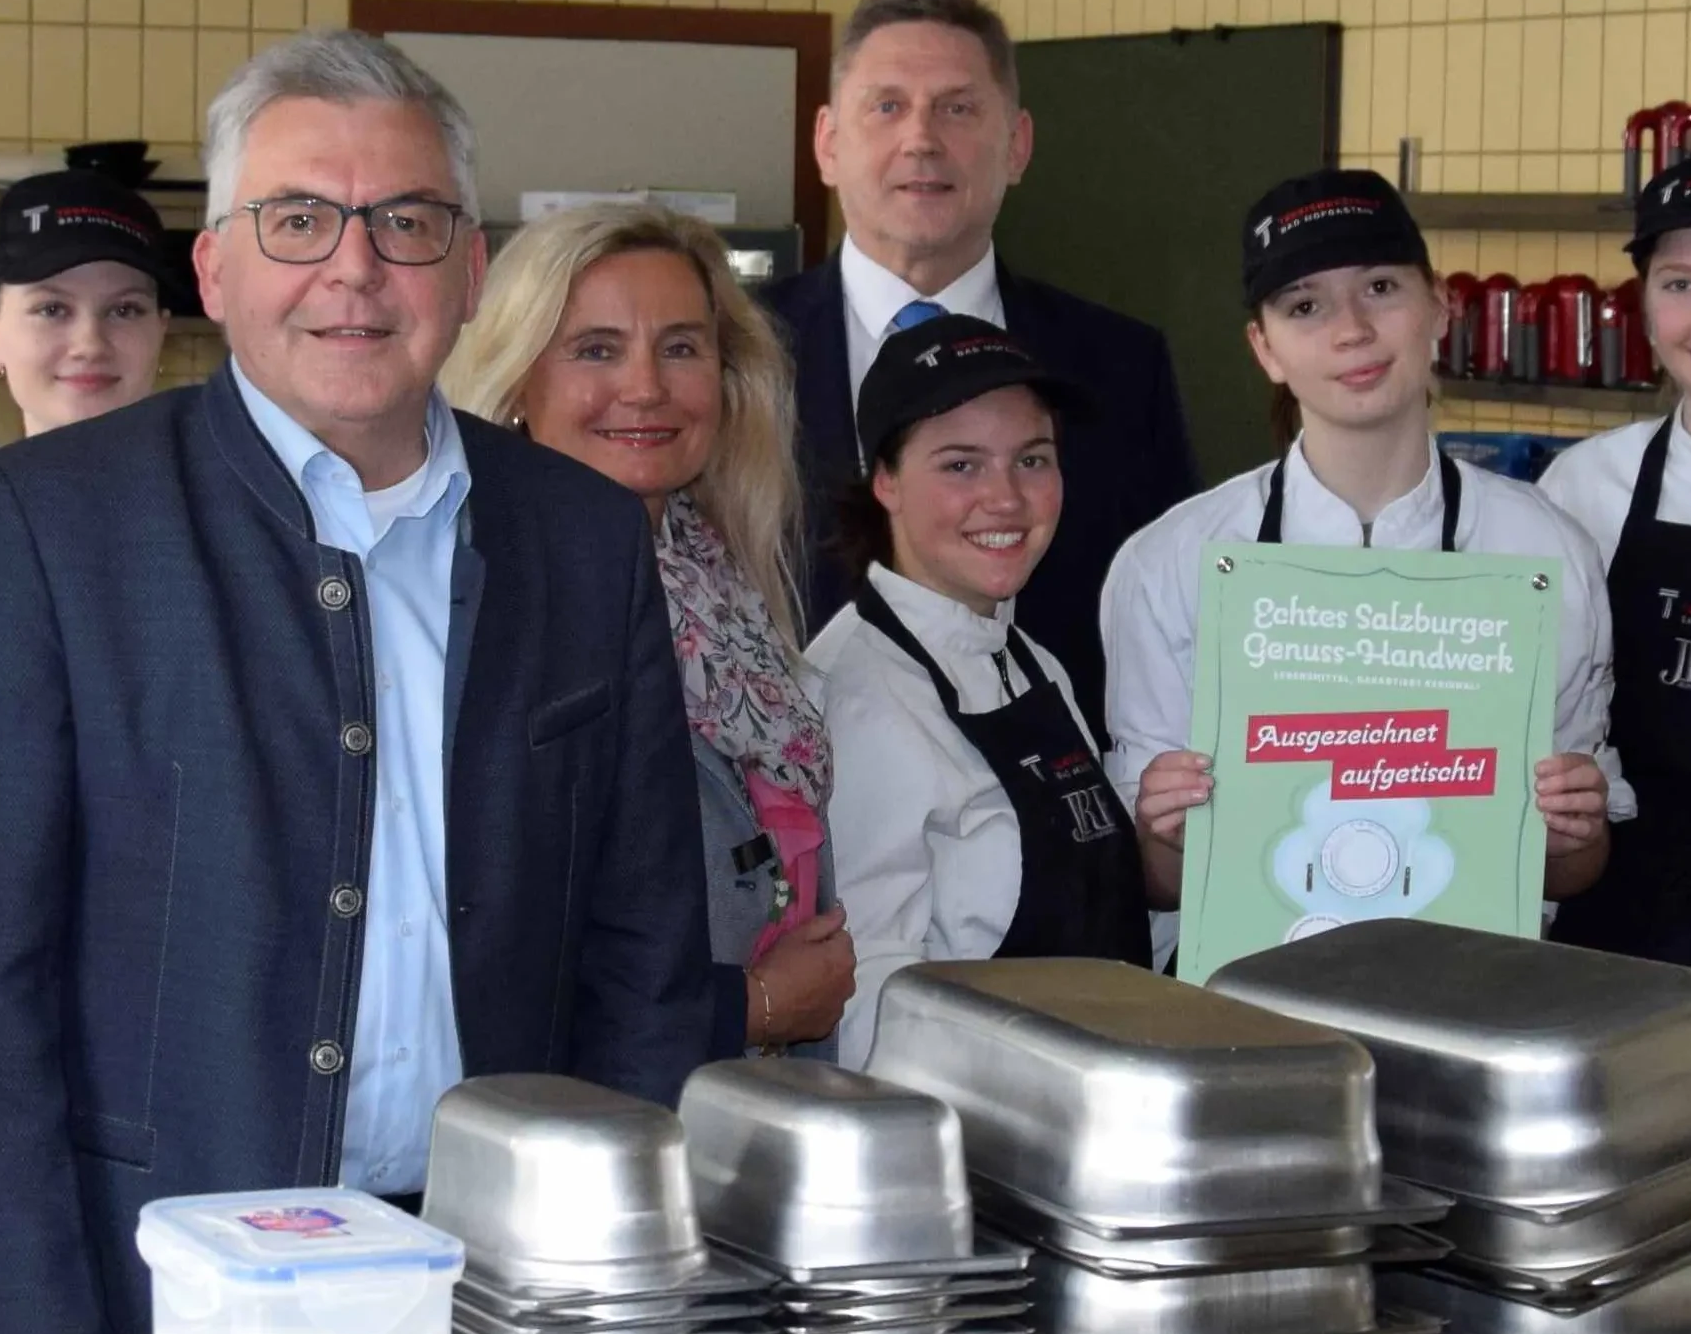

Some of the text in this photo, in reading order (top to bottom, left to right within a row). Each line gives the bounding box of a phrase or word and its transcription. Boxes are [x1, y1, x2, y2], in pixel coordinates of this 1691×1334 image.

[22, 204, 49, 233] T
[1254, 215, 1273, 248] T
[915, 344, 942, 368] T
[1253, 595, 1509, 644] Echtes Salzburger
[1659, 587, 1680, 619] T
[1243, 632, 1514, 674] Genuss-Handwerk
[1249, 718, 1438, 753] Ausgezeichnet
[1019, 754, 1047, 782] T
[1340, 755, 1487, 792] aufgetischt!
